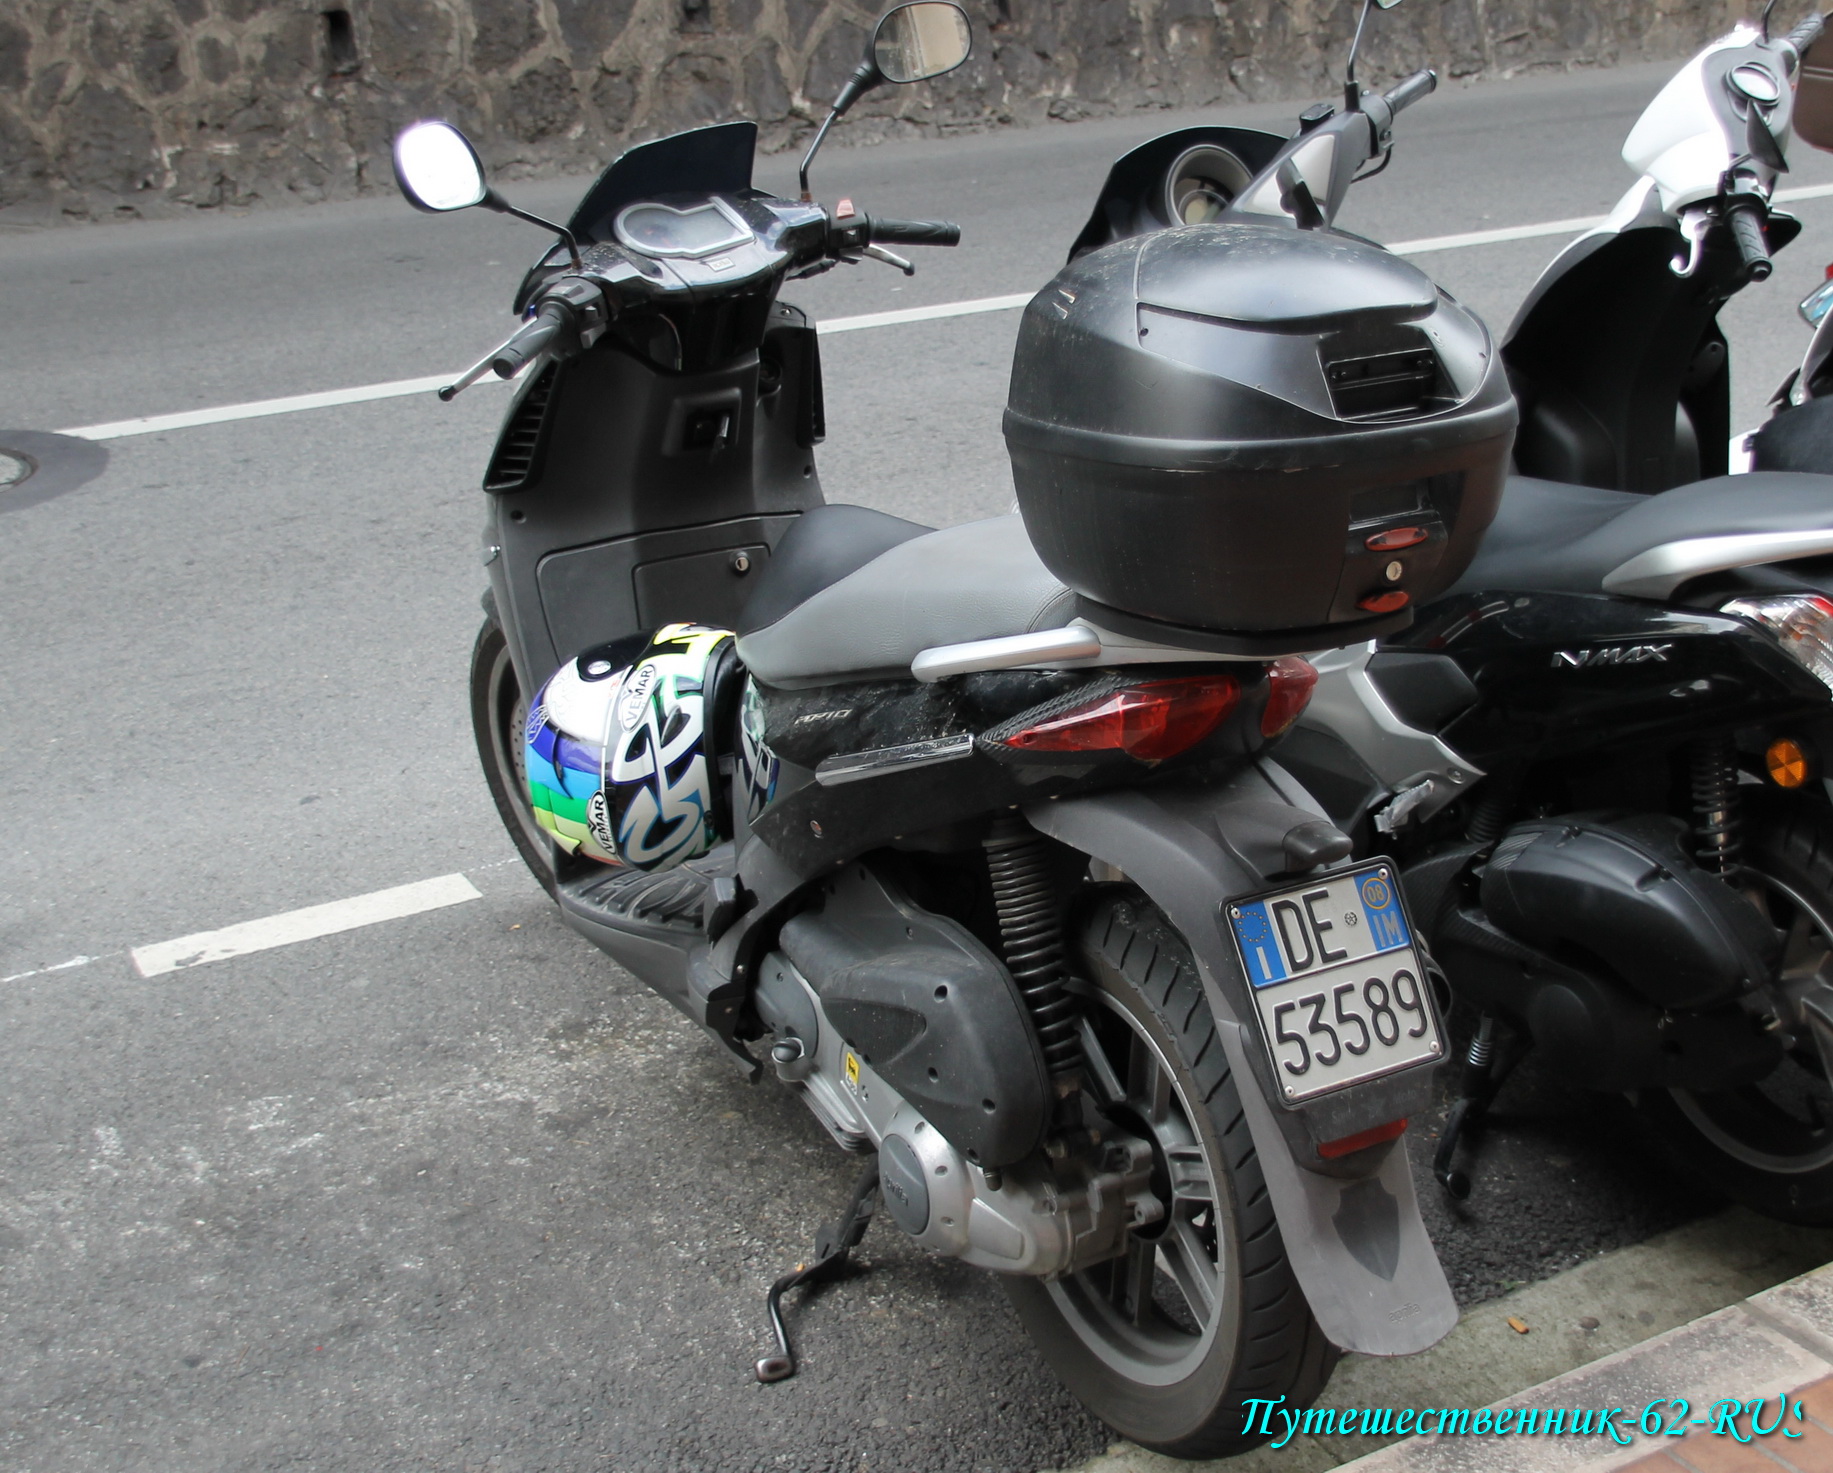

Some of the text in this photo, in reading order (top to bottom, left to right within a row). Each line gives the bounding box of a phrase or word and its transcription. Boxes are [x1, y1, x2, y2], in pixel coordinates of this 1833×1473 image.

[1550, 643, 1674, 668] NMAX
[625, 669, 653, 722] VEMAR
[594, 800, 613, 851] VEMAR
[1366, 883, 1384, 902] 08
[1271, 888, 1348, 973] DE
[1372, 911, 1404, 948] IM
[1255, 946, 1272, 980] I
[1273, 968, 1428, 1076] 53589
[1387, 1302, 1422, 1324] aprilia
